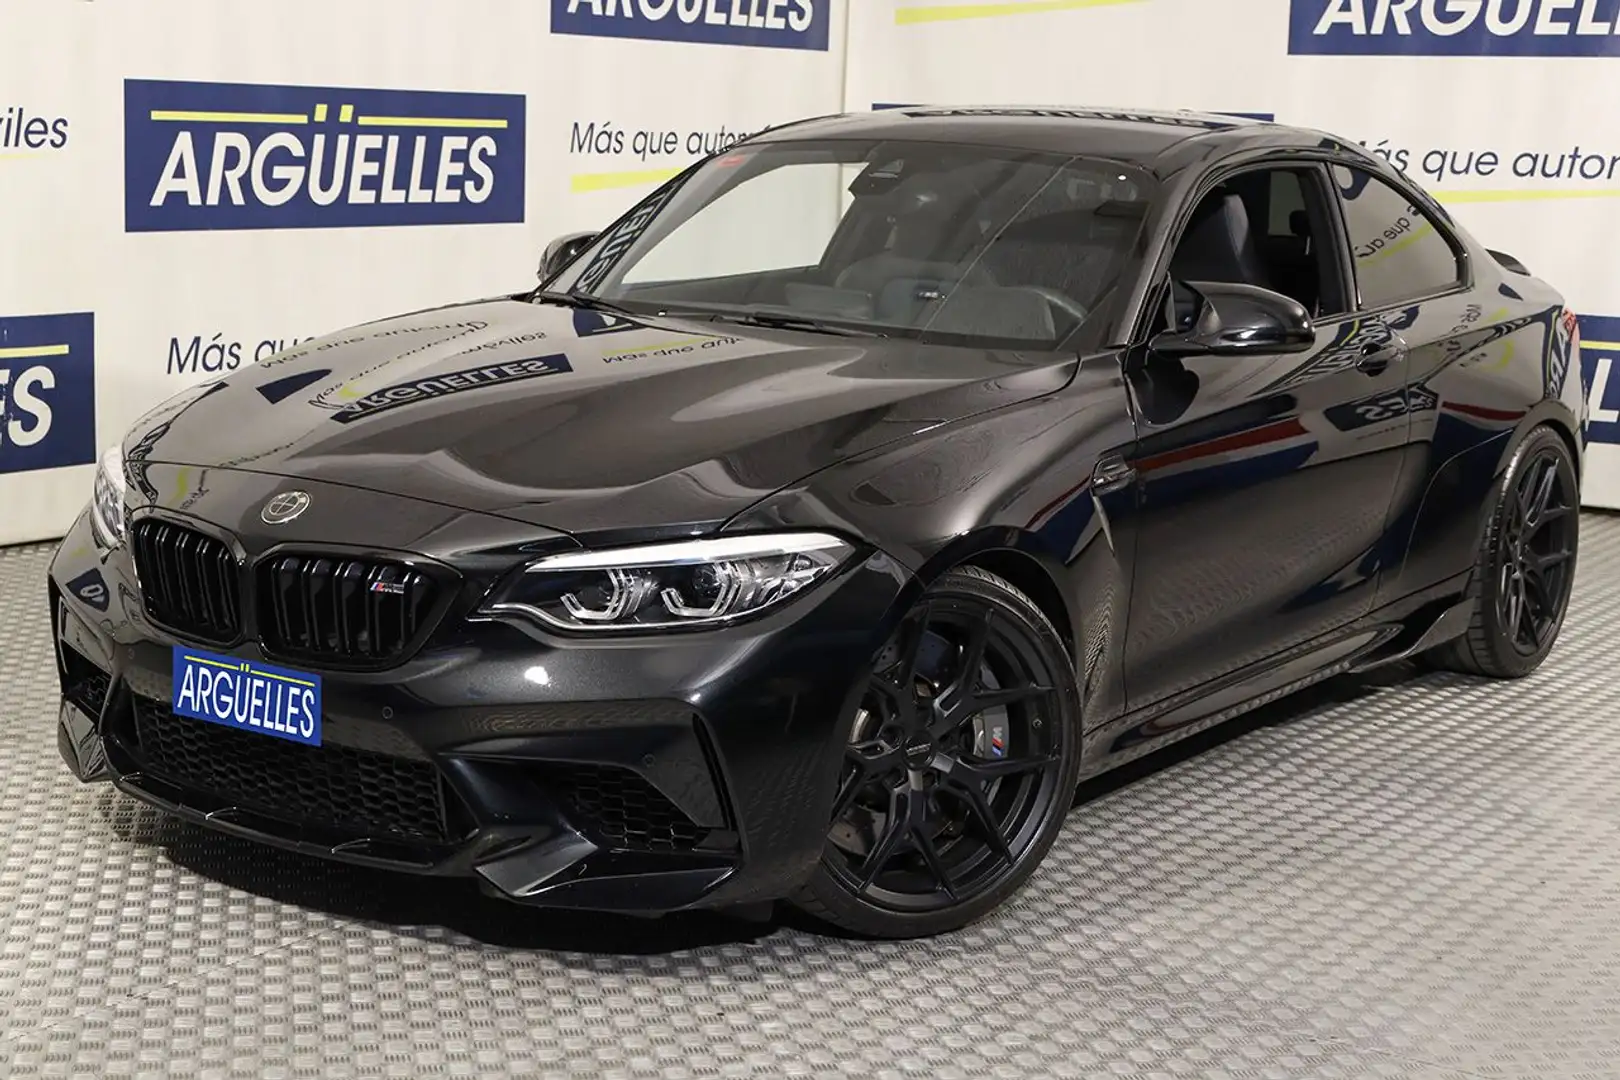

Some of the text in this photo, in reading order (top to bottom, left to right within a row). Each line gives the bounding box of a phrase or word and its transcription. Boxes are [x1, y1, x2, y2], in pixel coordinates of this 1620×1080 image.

[151, 104, 498, 207] ARGÜELLES
[570, 121, 625, 154] Más
[632, 131, 678, 162] que
[1422, 149, 1499, 182] que
[166, 332, 242, 375] Más
[0, 365, 56, 447] S
[177, 663, 316, 738] ARGÜELLES
